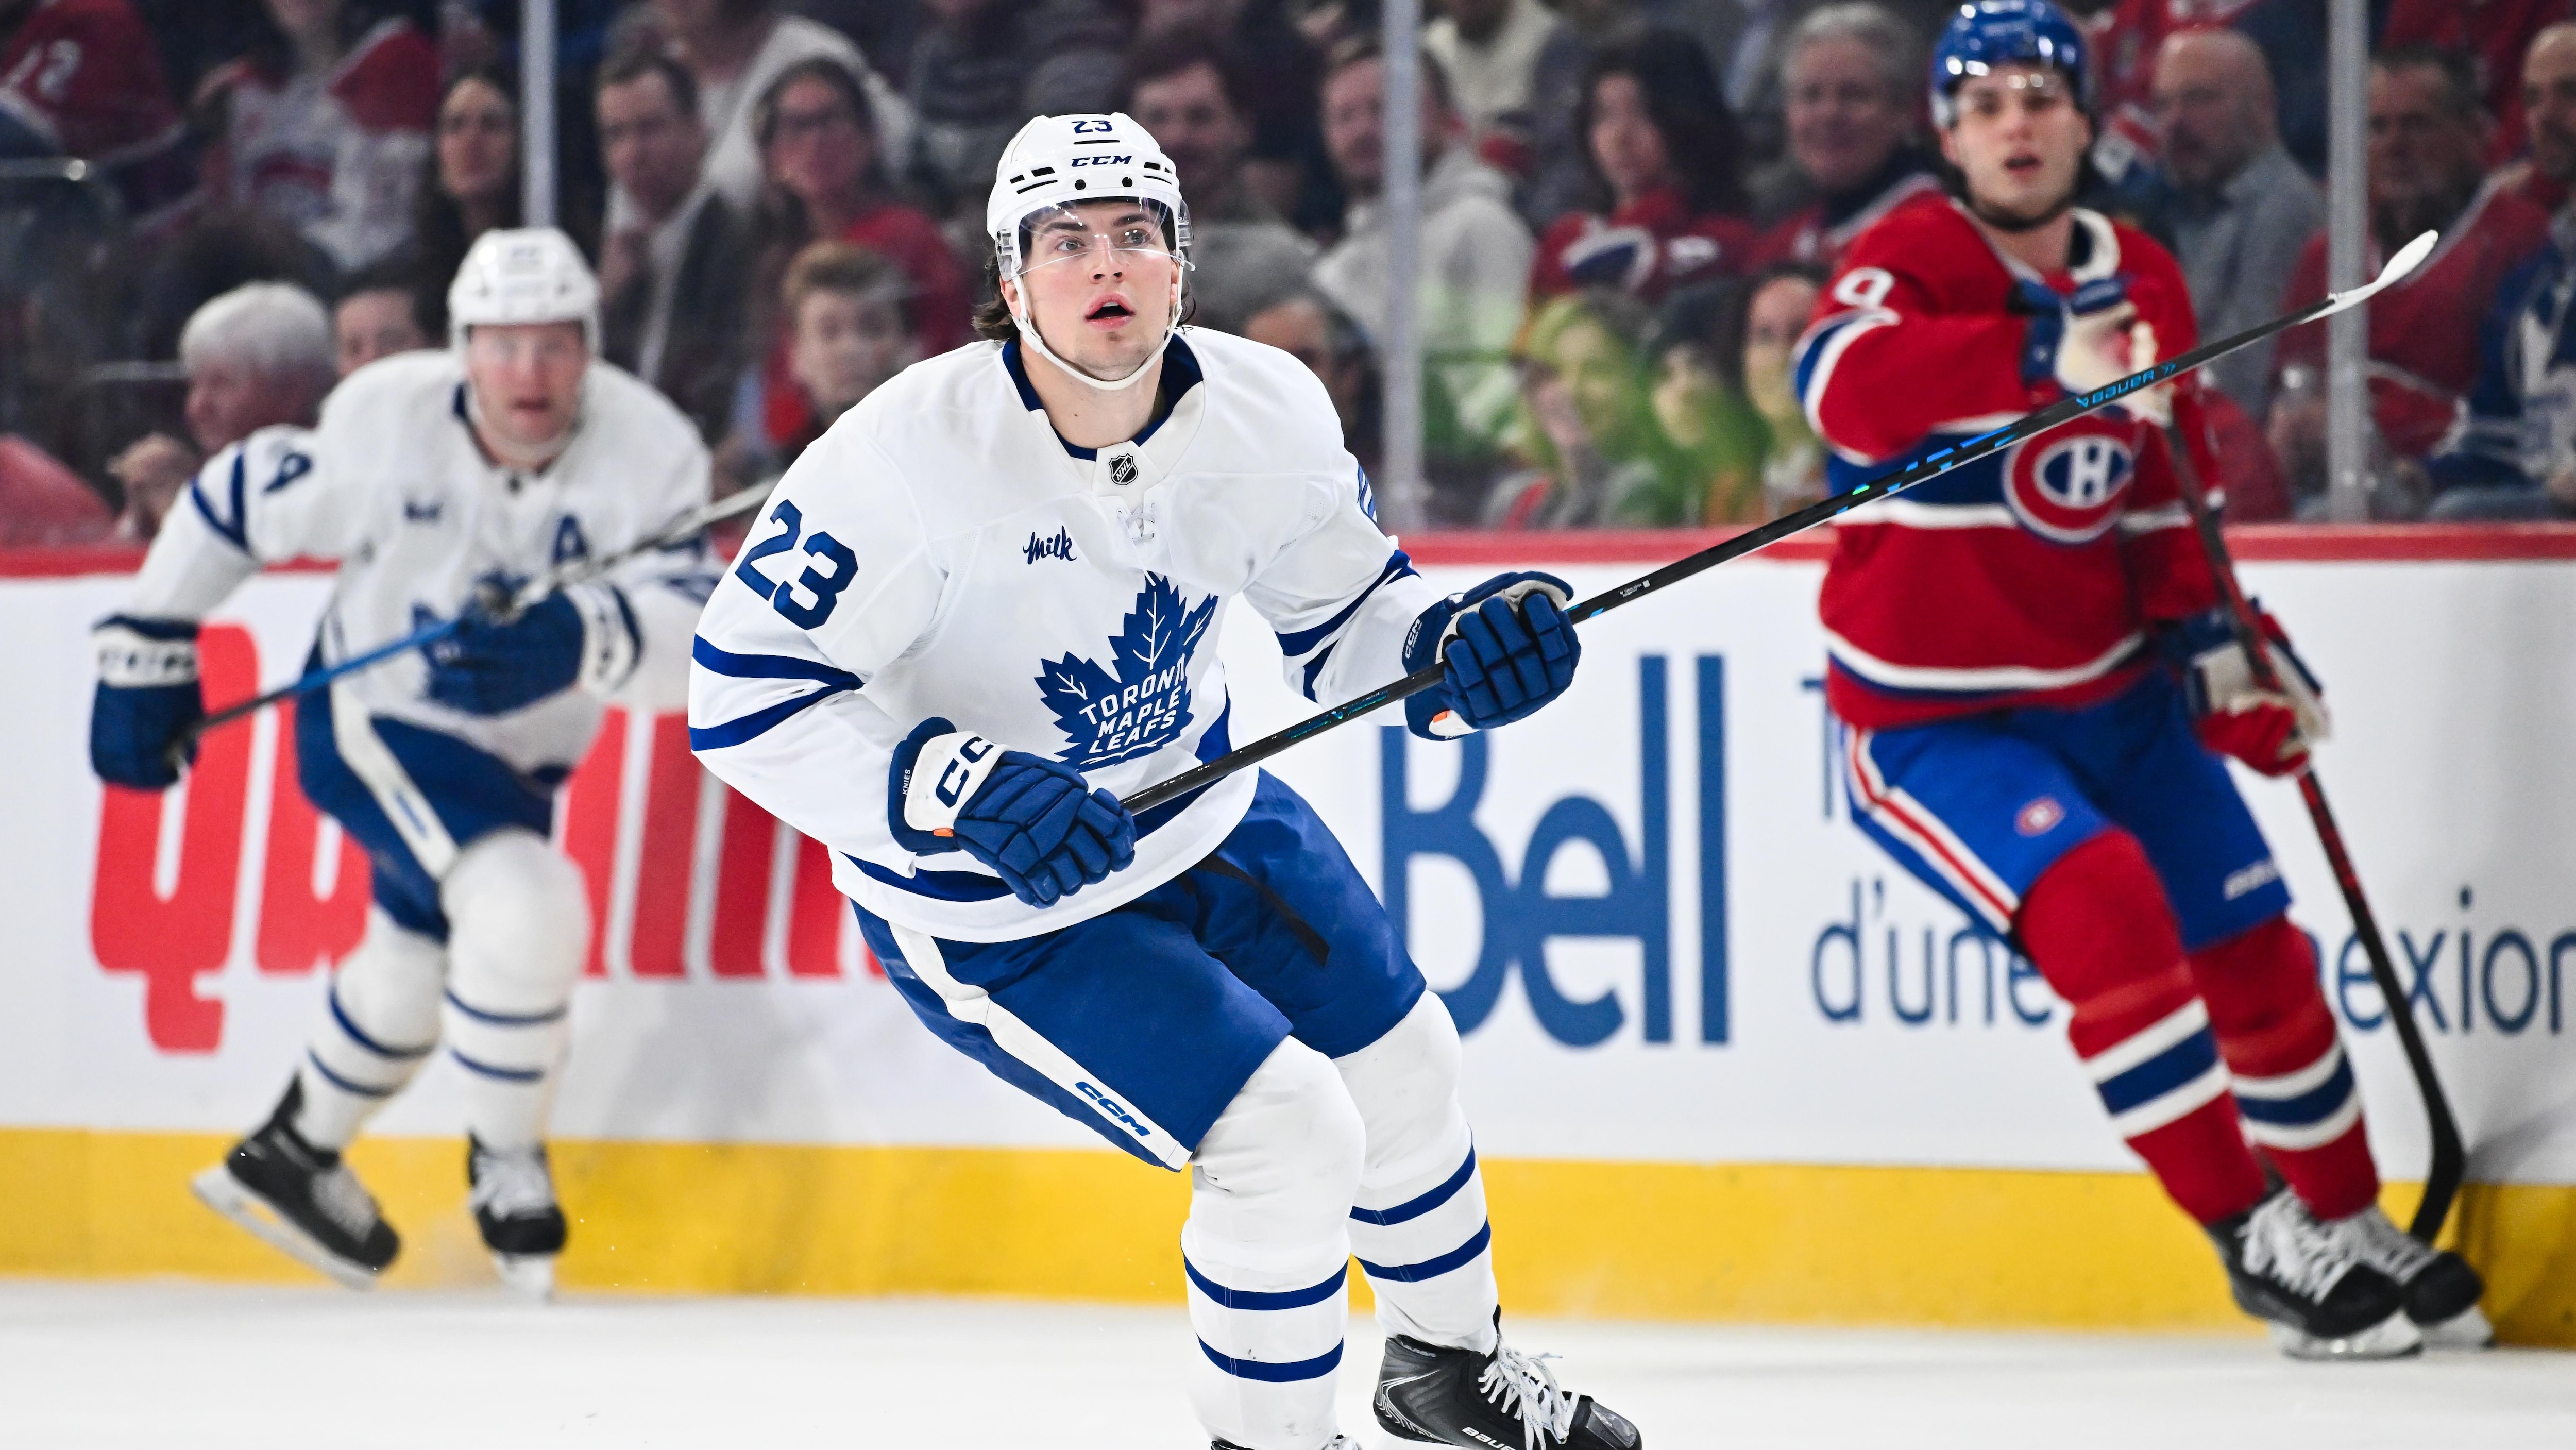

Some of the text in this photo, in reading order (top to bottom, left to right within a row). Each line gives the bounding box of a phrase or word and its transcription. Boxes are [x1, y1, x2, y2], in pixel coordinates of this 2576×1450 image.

[1071, 120, 1113, 134] 23
[1072, 156, 1132, 167] CCM
[1115, 460, 1131, 481] NHL
[551, 514, 588, 564] A
[735, 499, 859, 630] 23
[1405, 618, 1421, 659] CCM
[1088, 709, 1177, 754] LEAFS
[1097, 685, 1181, 738] MAPLE
[902, 769, 911, 795] KNIES
[1381, 653, 1730, 1052] Bell
[1811, 876, 2576, 1033] d'une exion
[1075, 1081, 1150, 1137] CCM
